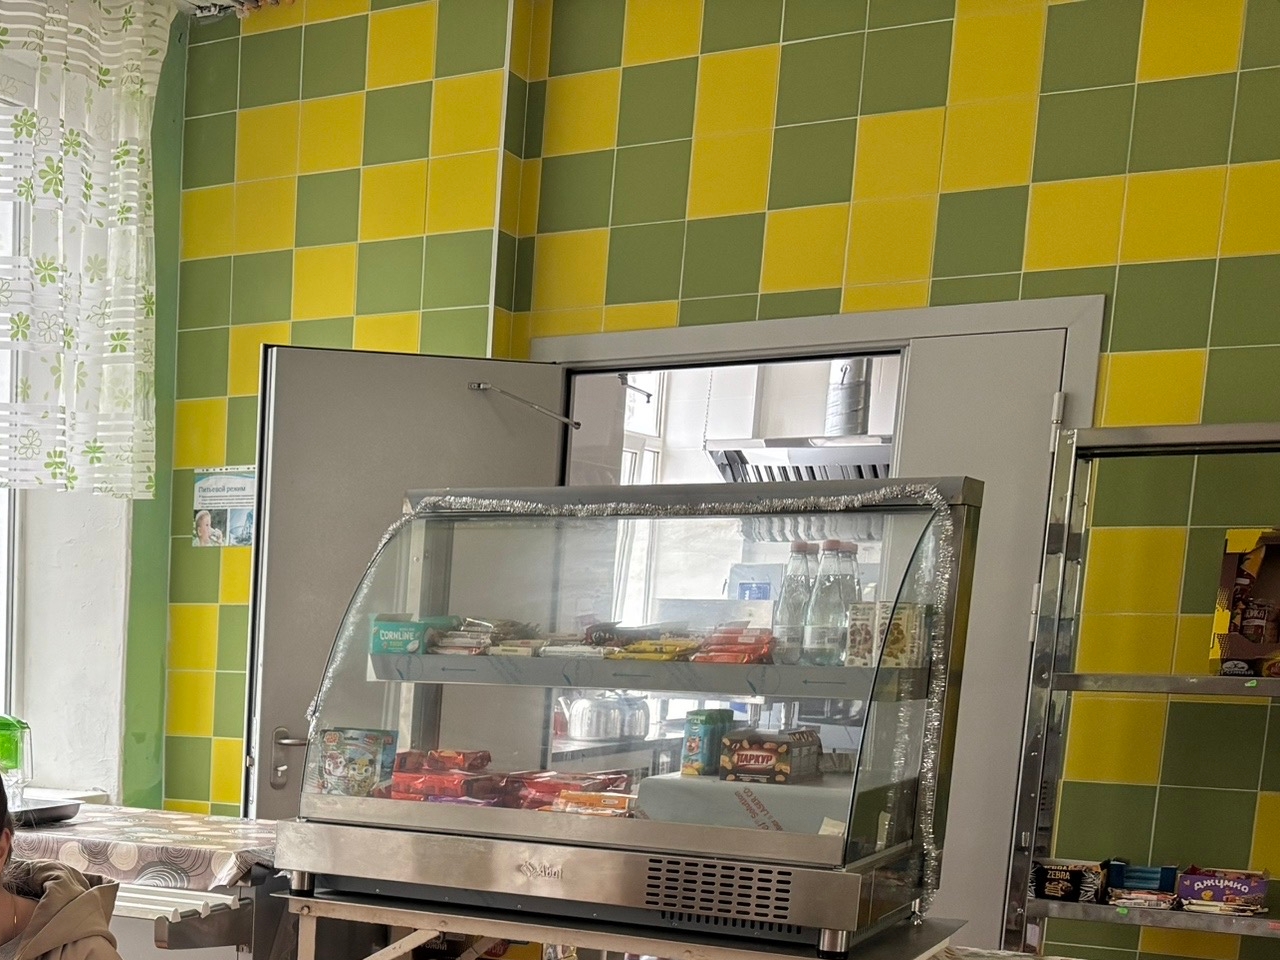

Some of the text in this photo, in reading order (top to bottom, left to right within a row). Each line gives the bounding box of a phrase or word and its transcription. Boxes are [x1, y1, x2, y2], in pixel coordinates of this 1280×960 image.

[379, 630, 415, 640] CORNLINE
[736, 752, 773, 765] ПАРКУР
[751, 799, 769, 816] LASER
[1047, 870, 1070, 880] ZEBRA
